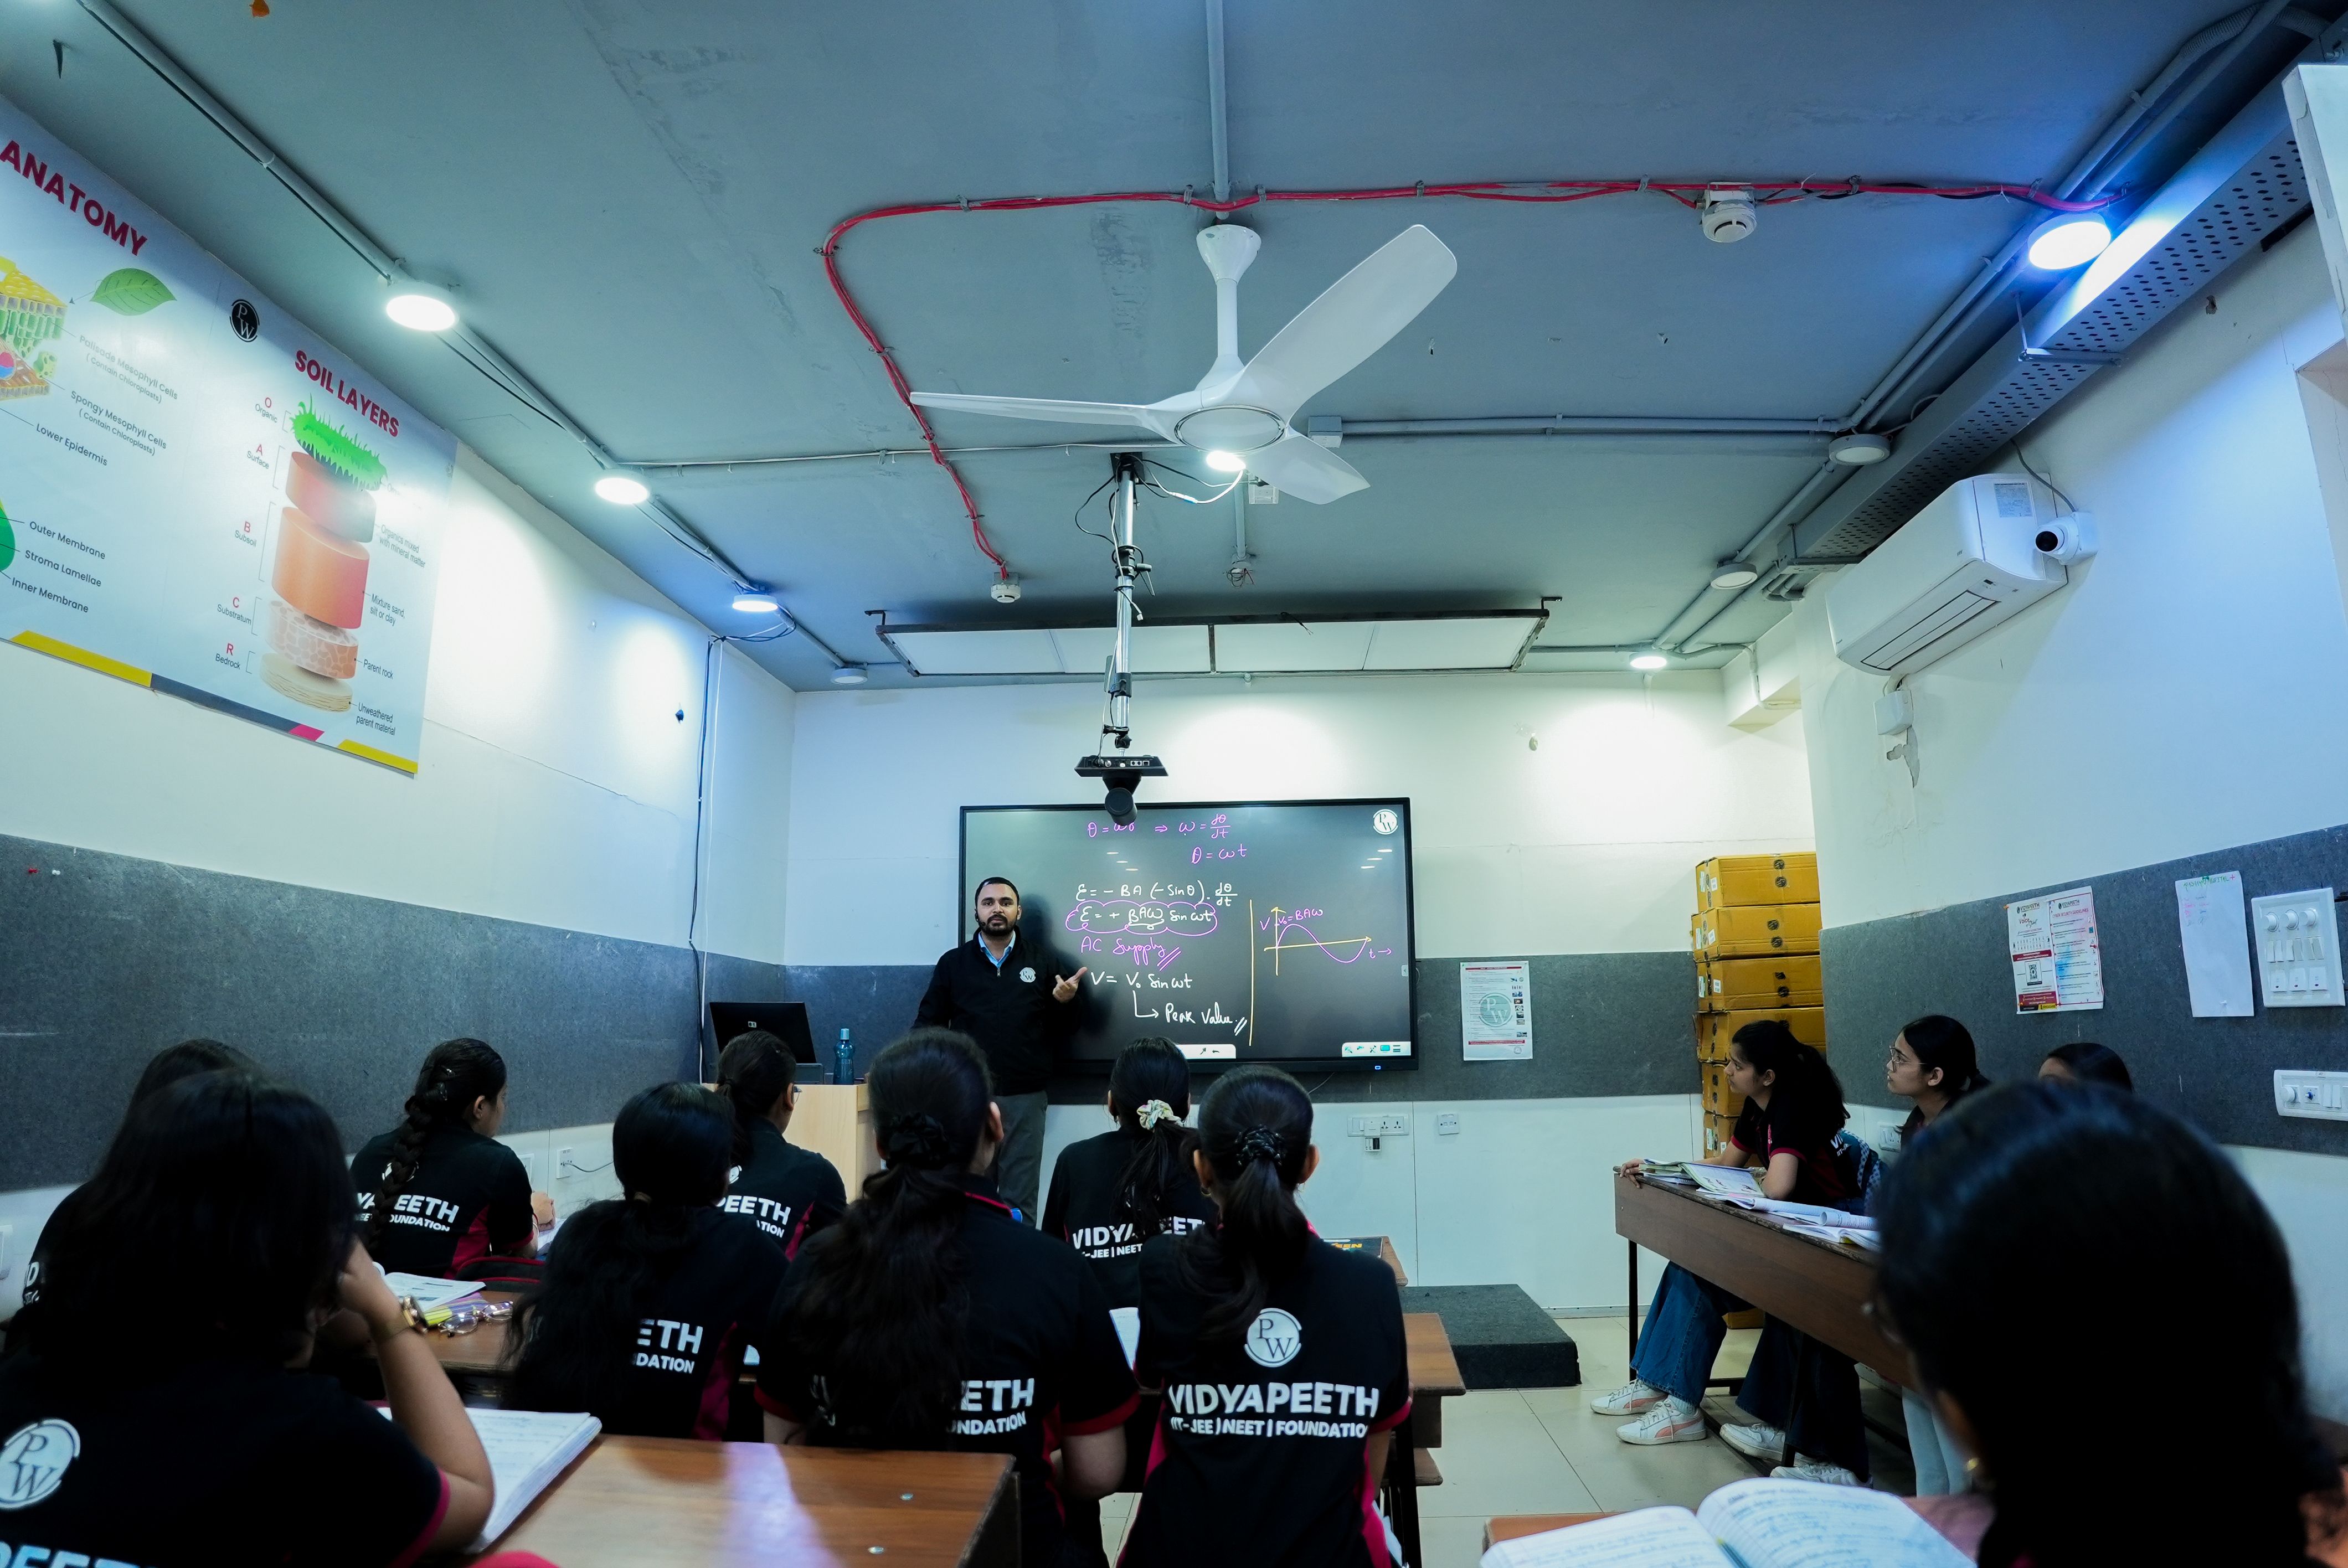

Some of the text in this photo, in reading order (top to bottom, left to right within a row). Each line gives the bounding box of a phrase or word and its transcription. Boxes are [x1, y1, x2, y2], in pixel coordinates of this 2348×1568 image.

[0, 140, 147, 256] ANATOMY
[79, 335, 178, 400] Palisade Mesophyll Cells
[119, 373, 162, 404] Chloroplasts)
[295, 350, 399, 437] SOIL LAYERS
[255, 404, 278, 424] Organic
[265, 397, 272, 408] O
[71, 390, 167, 450] Spongy Mesophyll Cells
[36, 423, 108, 467] Lower Epidermis
[112, 427, 156, 457] Chloroplasts)
[256, 443, 263, 456] A
[246, 451, 270, 470] Surface
[234, 530, 257, 548] Subsoil
[244, 521, 251, 533] B
[381, 524, 419, 554] Organics mixed
[29, 521, 106, 559] Outer Membrane
[379, 537, 426, 569] with mineral matter
[25, 550, 102, 587] Stroma Lamellae
[12, 577, 89, 613] Inner Membrane
[233, 597, 240, 608] C
[371, 593, 405, 619] Mixture sand,
[217, 604, 252, 626] Substratum
[370, 606, 396, 627] silt or clay
[215, 653, 240, 670] Bedrock
[226, 643, 234, 656] R
[363, 659, 394, 680] Parent rock
[358, 702, 394, 724] Unweathered
[356, 715, 396, 736] parent material
[1081, 936, 1166, 966] AC Supply
[1116, 1244, 1143, 1256] NEET
[960, 1378, 1035, 1412] ETH
[1168, 1381, 1379, 1418] VIDYAPEETH
[1222, 1419, 1265, 1432] NEET
[1275, 1420, 1368, 1439] FOUNDATIO
